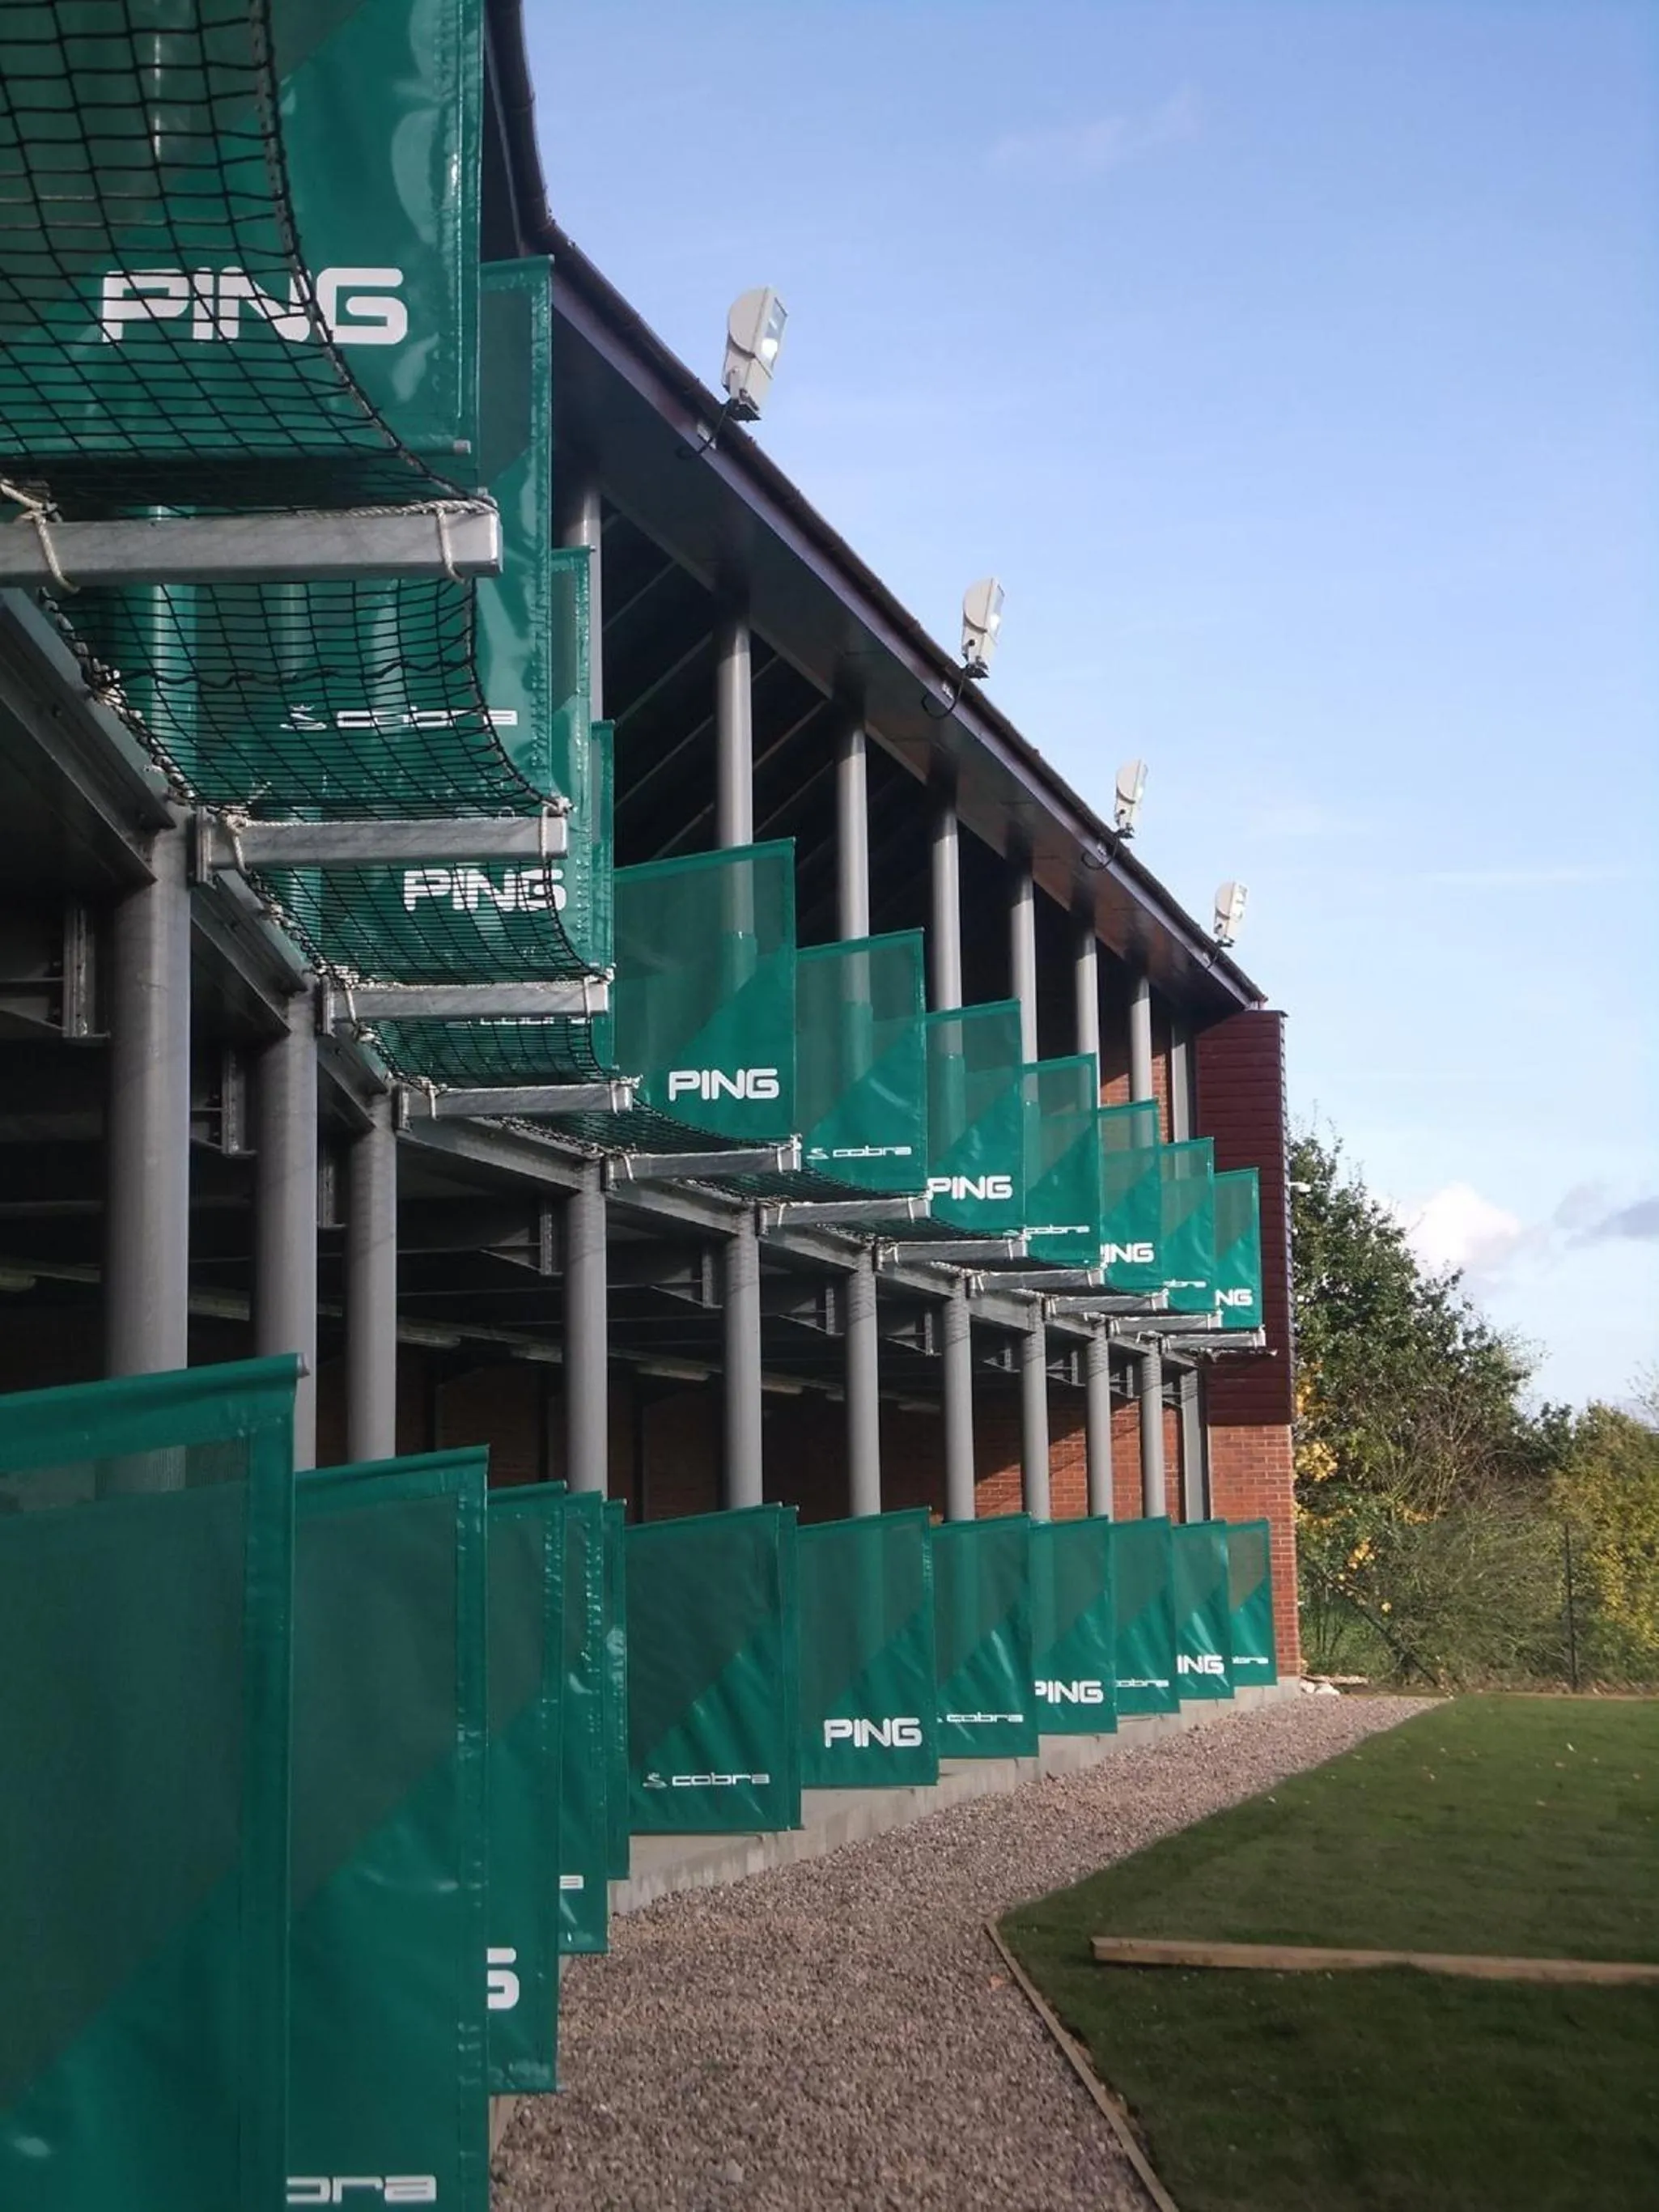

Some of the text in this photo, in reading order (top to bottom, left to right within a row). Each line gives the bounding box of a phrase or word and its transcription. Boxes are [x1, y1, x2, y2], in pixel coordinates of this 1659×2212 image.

[102, 267, 407, 345] PING
[404, 868, 567, 912] PING
[668, 1068, 779, 1102] PING
[832, 1145, 912, 1158] cobra
[927, 1175, 1012, 1201] PING
[1100, 1242, 1154, 1263] ING
[1215, 1289, 1254, 1306] NG
[1177, 1654, 1224, 1675] ING
[946, 1711, 1024, 1723] cobra
[823, 1717, 922, 1748] PING
[672, 1771, 770, 1787] cobra
